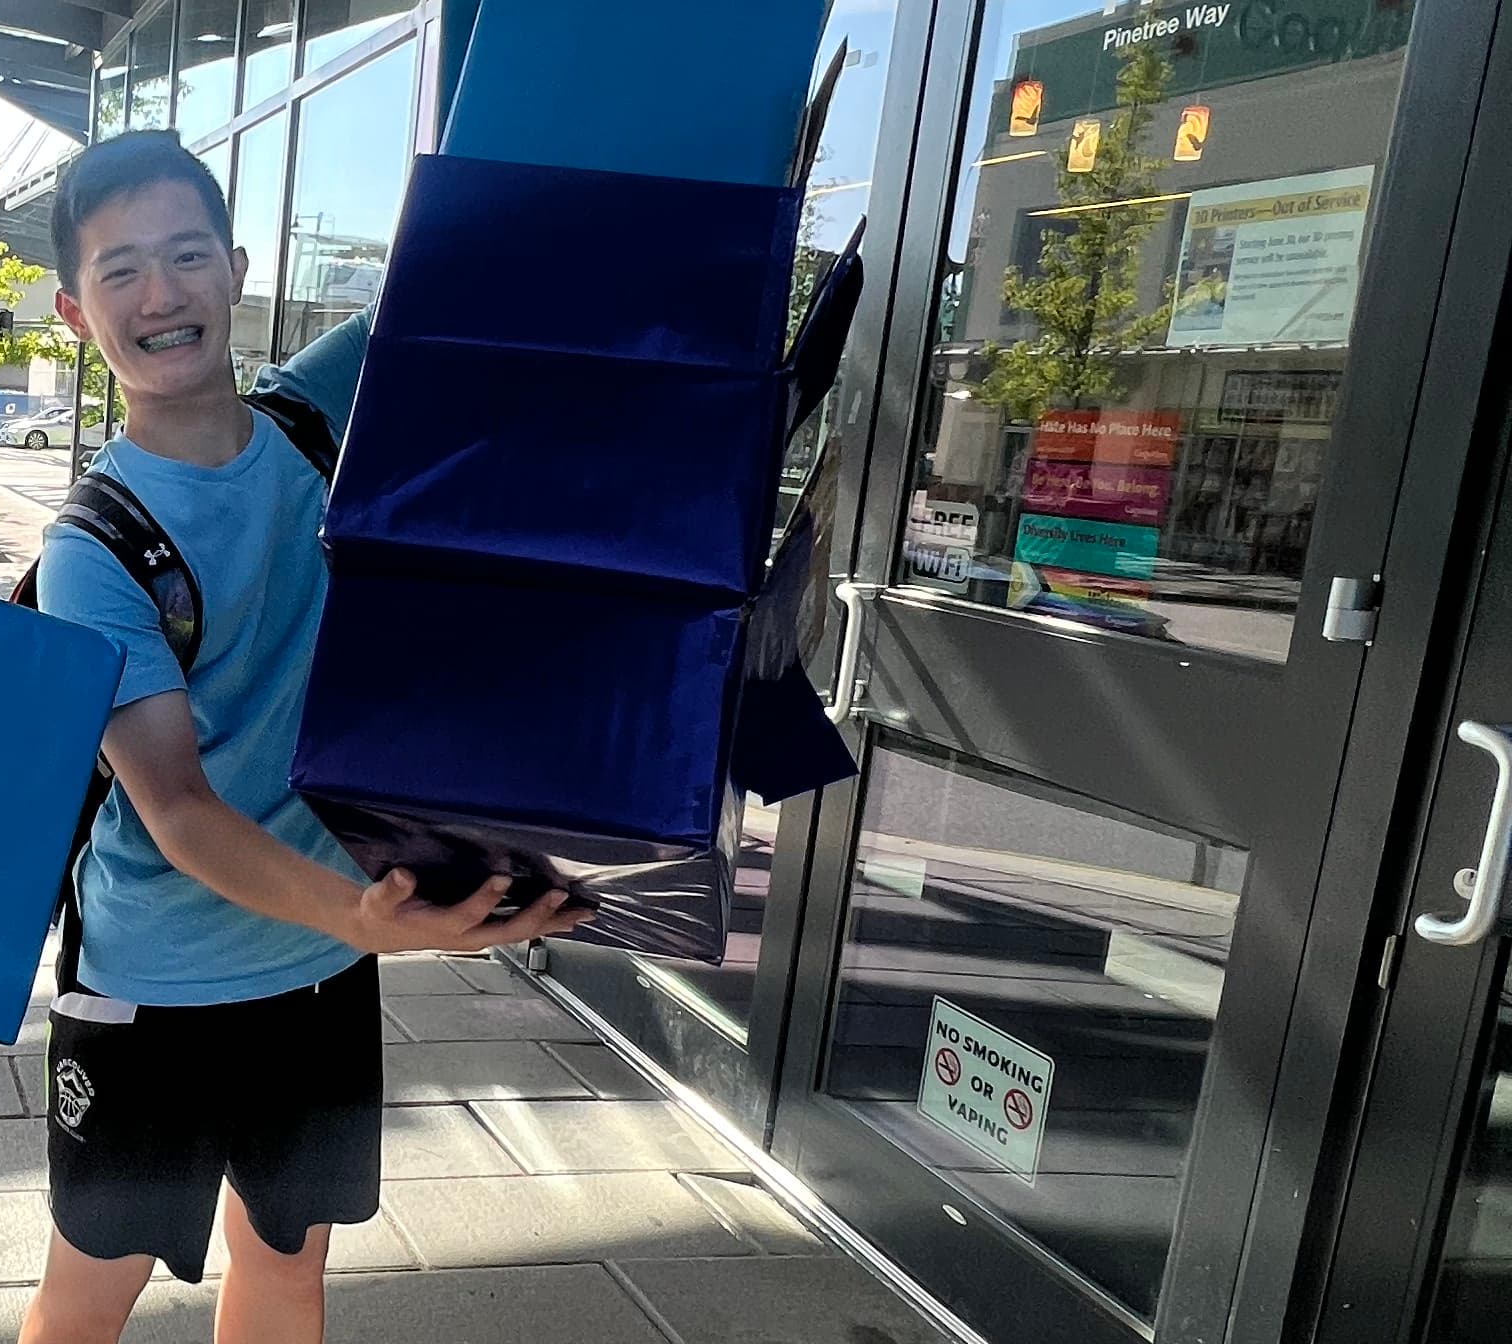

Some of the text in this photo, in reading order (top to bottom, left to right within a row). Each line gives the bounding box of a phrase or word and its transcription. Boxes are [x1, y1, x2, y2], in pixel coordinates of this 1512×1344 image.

[1103, 15, 1179, 51] Pinetree
[1185, 3, 1230, 32] Way
[1312, 191, 1361, 211] Service
[1039, 420, 1172, 437] Hate Has No Place Here
[1023, 524, 1127, 548] Diversity Lives Here
[936, 1019, 1044, 1094] NO SMOKING
[970, 1074, 994, 1101] OR
[947, 1093, 1009, 1146] VAPING
